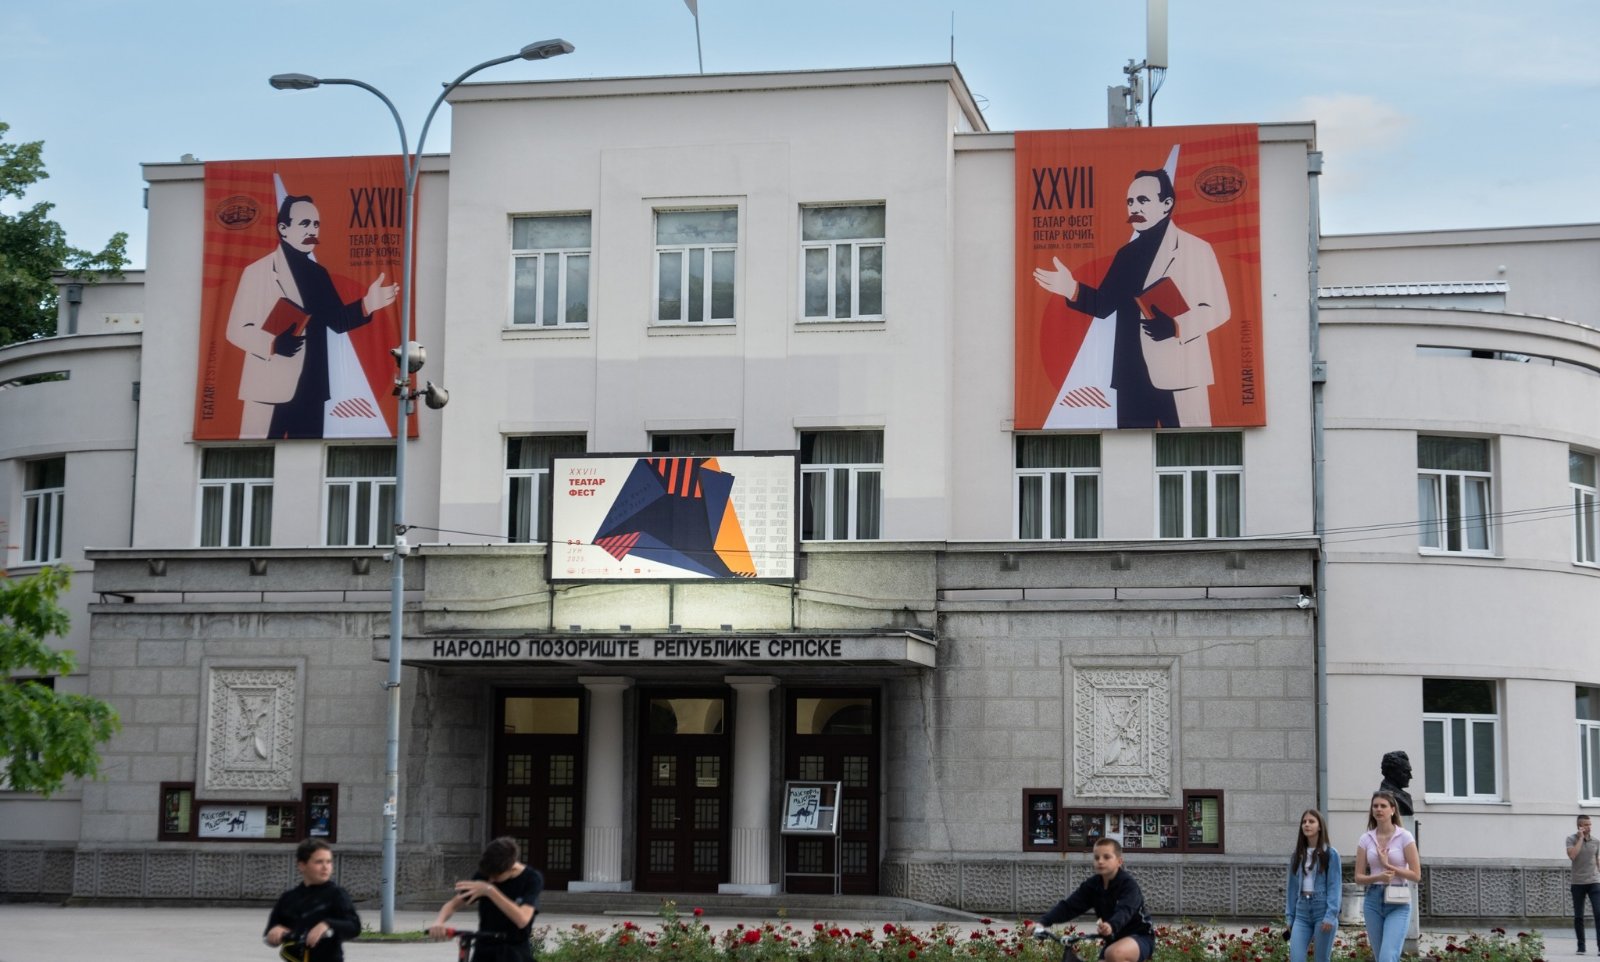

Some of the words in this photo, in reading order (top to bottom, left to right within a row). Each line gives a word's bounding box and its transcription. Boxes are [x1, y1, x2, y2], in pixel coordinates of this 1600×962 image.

[1032, 165, 1094, 210] XXVII
[349, 187, 403, 228] XXVII
[1032, 216, 1066, 228] ТЕАТАР
[1068, 214, 1094, 227] ФЕСТ
[349, 235, 379, 246] ТЕАТАР
[1033, 230, 1061, 241] ПЕТАР
[1062, 229, 1095, 240] КОЧИЋ
[350, 248, 375, 258] ПЕТАР
[1240, 320, 1255, 406] TEATARFEST.COM
[568, 467, 598, 476] XXVII
[568, 478, 606, 486] ТЕАТАР
[433, 639, 521, 658] НАРОДНО
[528, 639, 640, 658] ПОЗОРИШТЕ
[654, 639, 760, 658] РЕПУБЛИКЕ
[767, 638, 842, 657] СРПСКЕ
